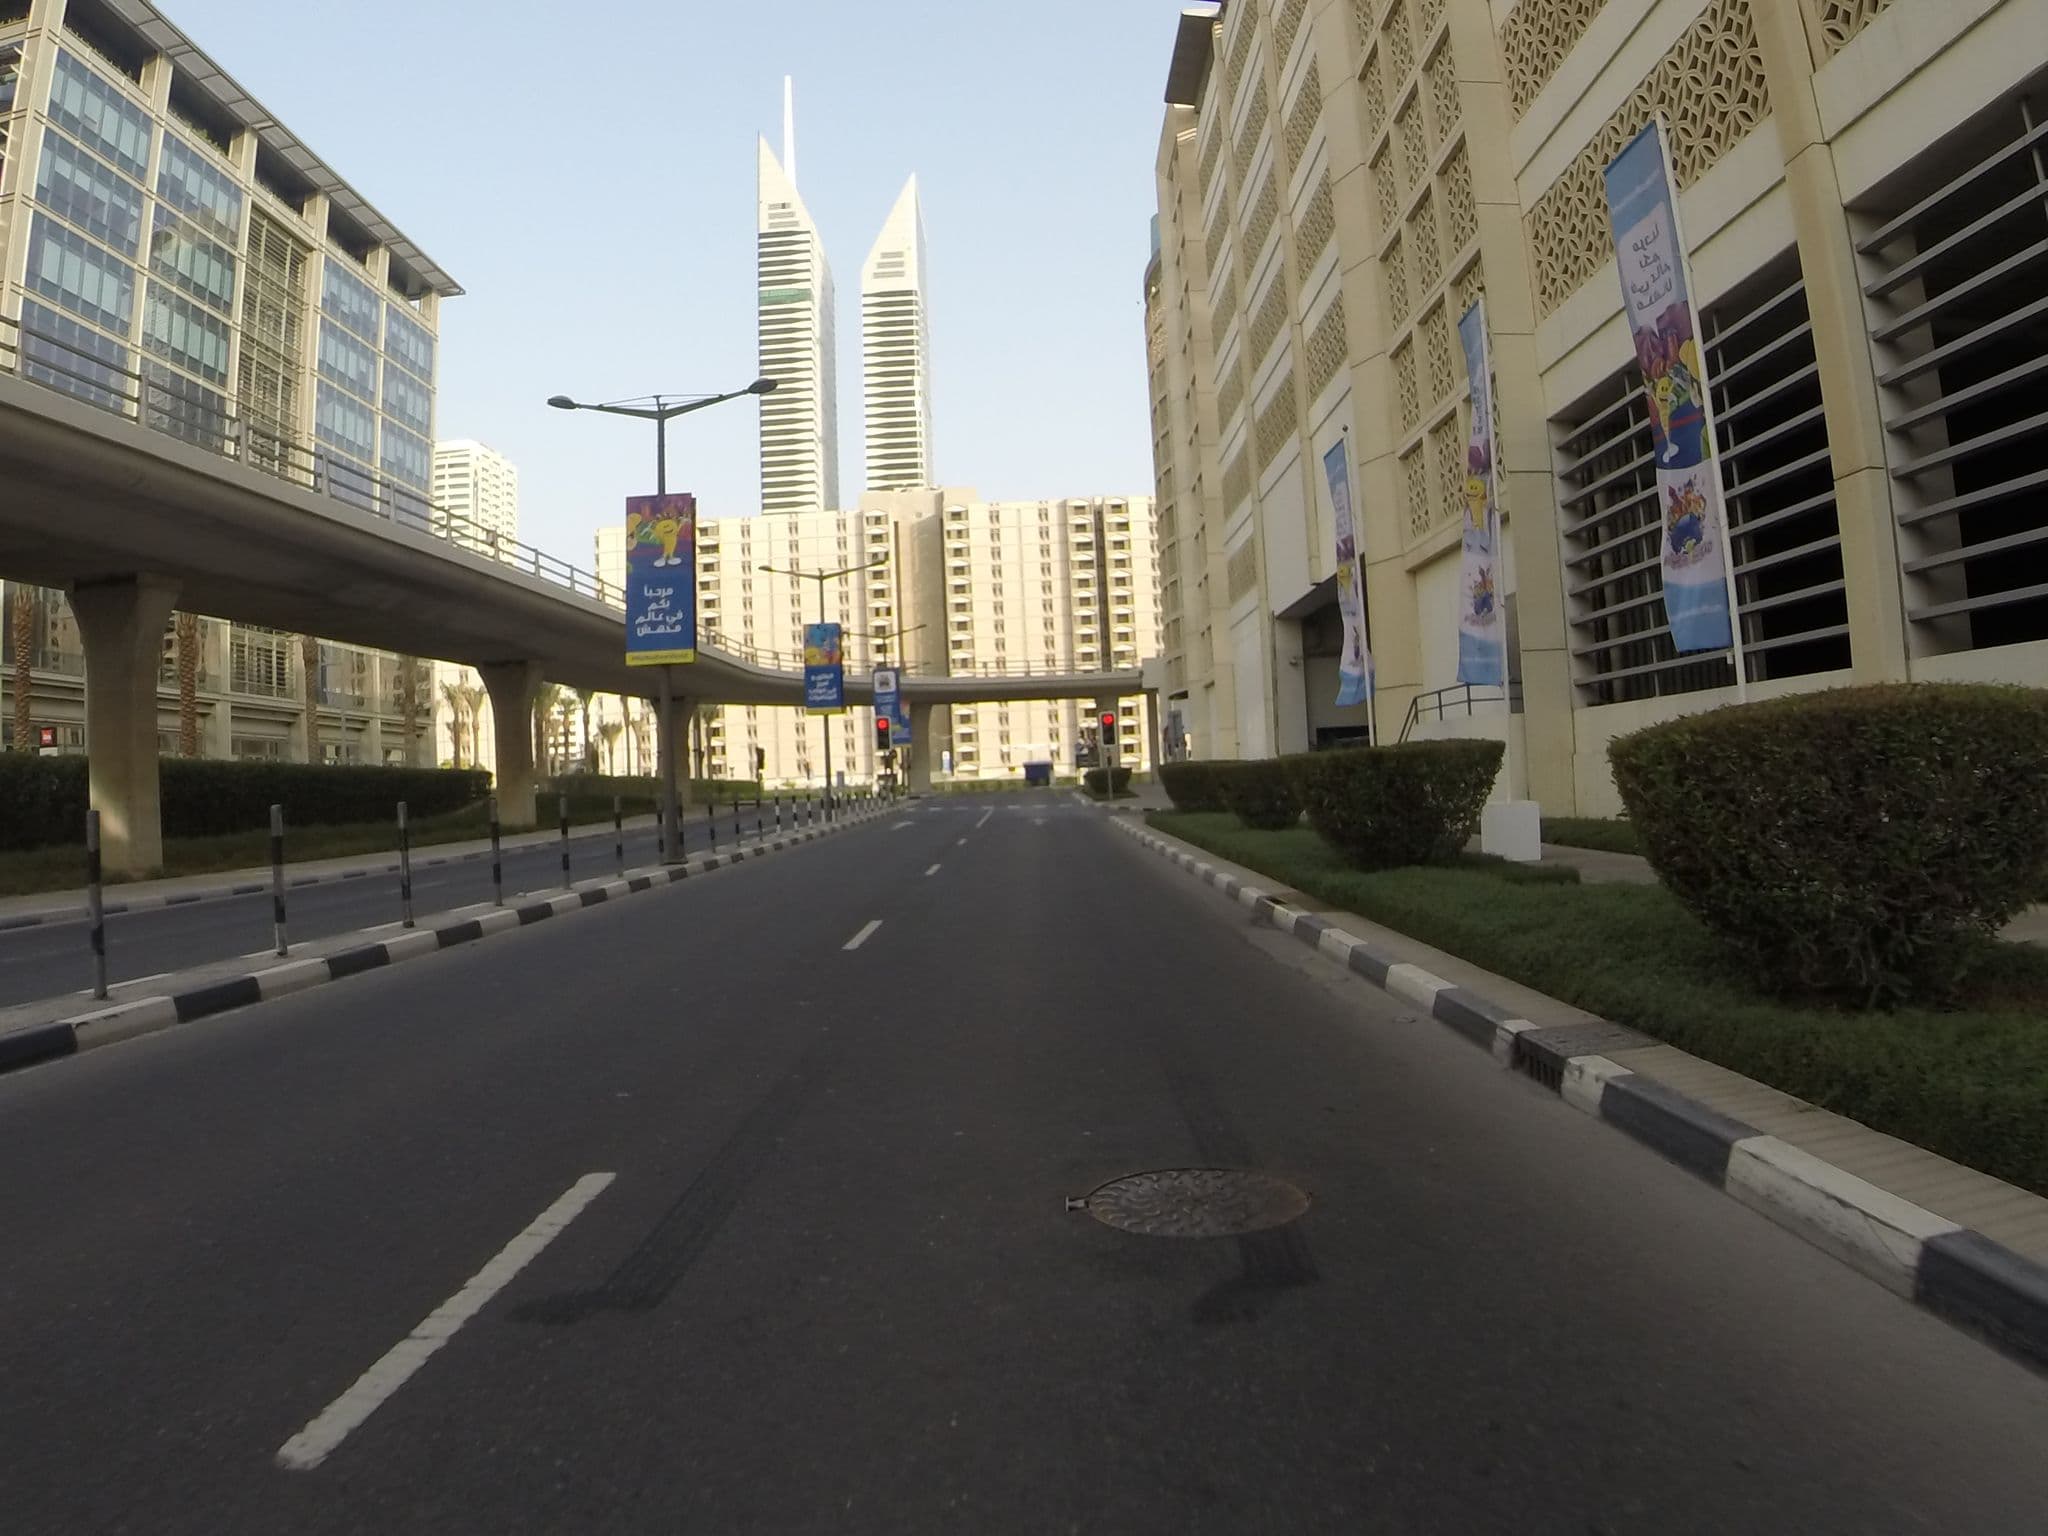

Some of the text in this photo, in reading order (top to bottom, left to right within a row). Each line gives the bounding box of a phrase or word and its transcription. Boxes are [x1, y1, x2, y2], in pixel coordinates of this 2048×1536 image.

[647, 598, 670, 611] بكم
[635, 610, 684, 625] في عالم
[636, 624, 682, 637] مدهش
